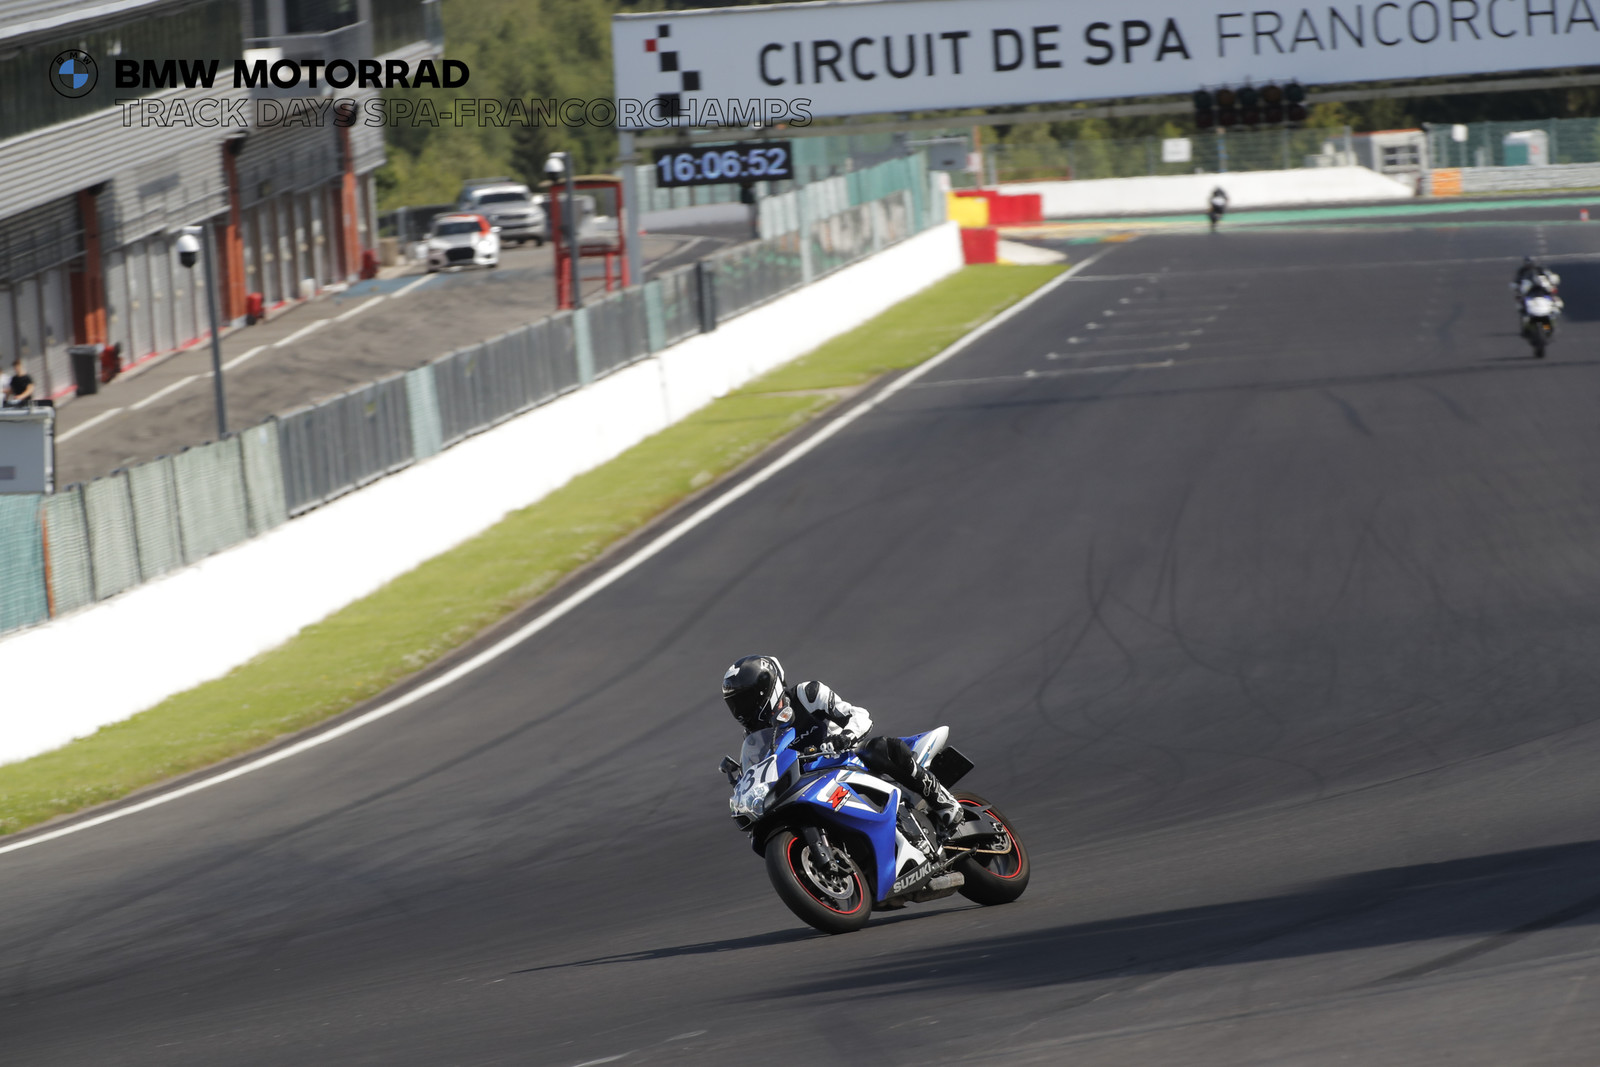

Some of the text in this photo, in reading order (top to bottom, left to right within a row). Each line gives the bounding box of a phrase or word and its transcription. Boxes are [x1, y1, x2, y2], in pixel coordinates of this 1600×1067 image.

[758, 0, 1600, 87] CIRCUIT DE SPA FRANCORCHA
[657, 147, 789, 182] 16:06:52
[893, 861, 932, 894] SUZUKI
